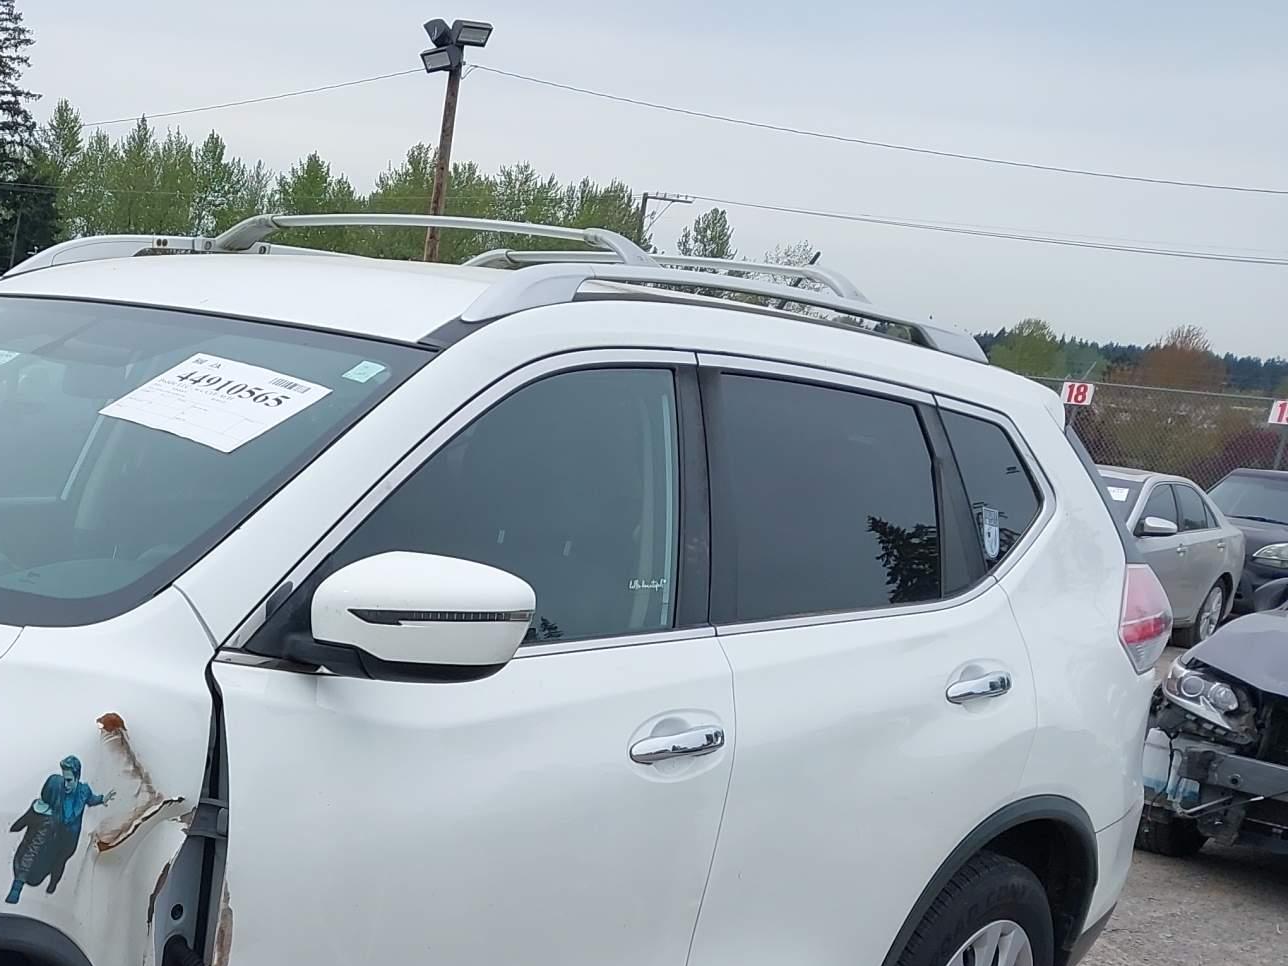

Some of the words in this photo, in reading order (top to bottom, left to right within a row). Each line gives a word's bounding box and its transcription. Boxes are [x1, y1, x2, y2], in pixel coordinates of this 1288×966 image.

[176, 370, 291, 408] 44910565
[1066, 384, 1088, 403] 18
[1276, 402, 1288, 423] 1
